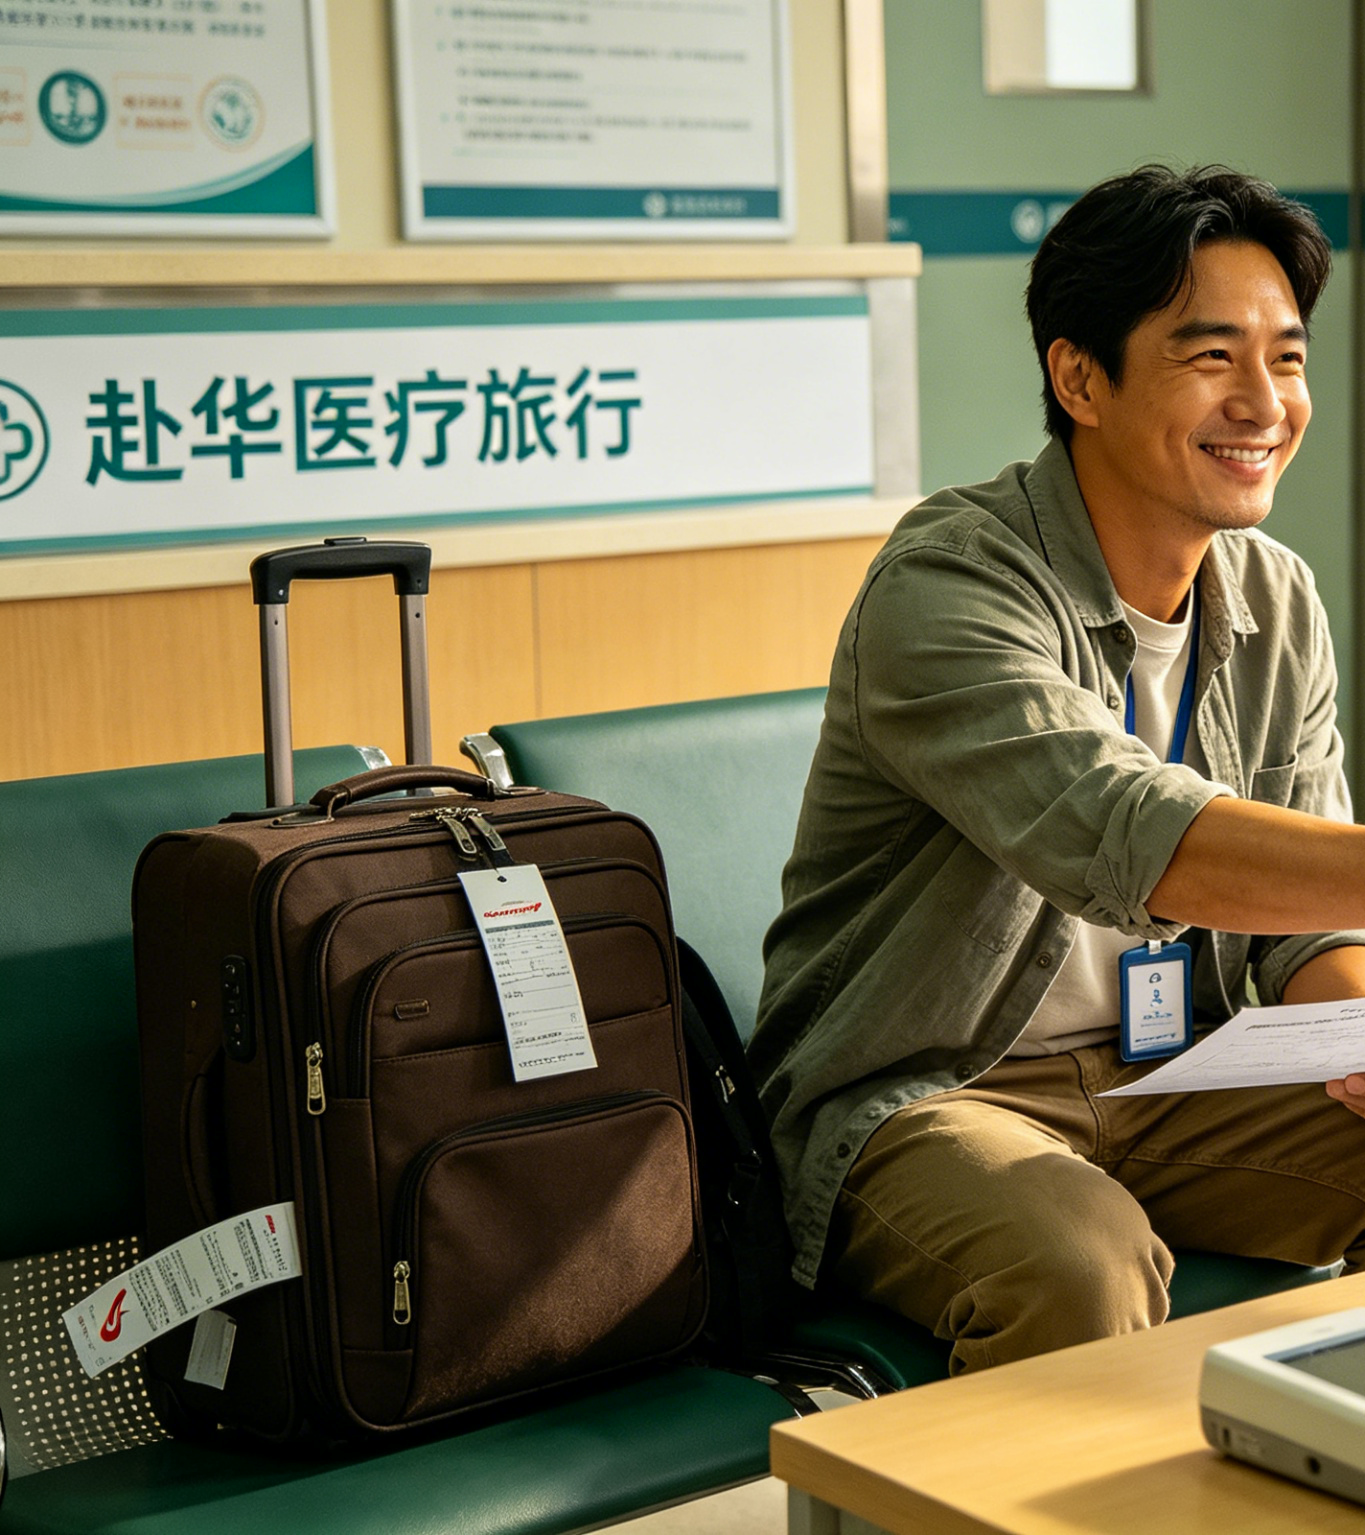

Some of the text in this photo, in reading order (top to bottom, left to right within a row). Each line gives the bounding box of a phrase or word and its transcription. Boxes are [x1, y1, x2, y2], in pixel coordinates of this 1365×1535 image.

[85, 367, 642, 486] 赴华医疗旅行
